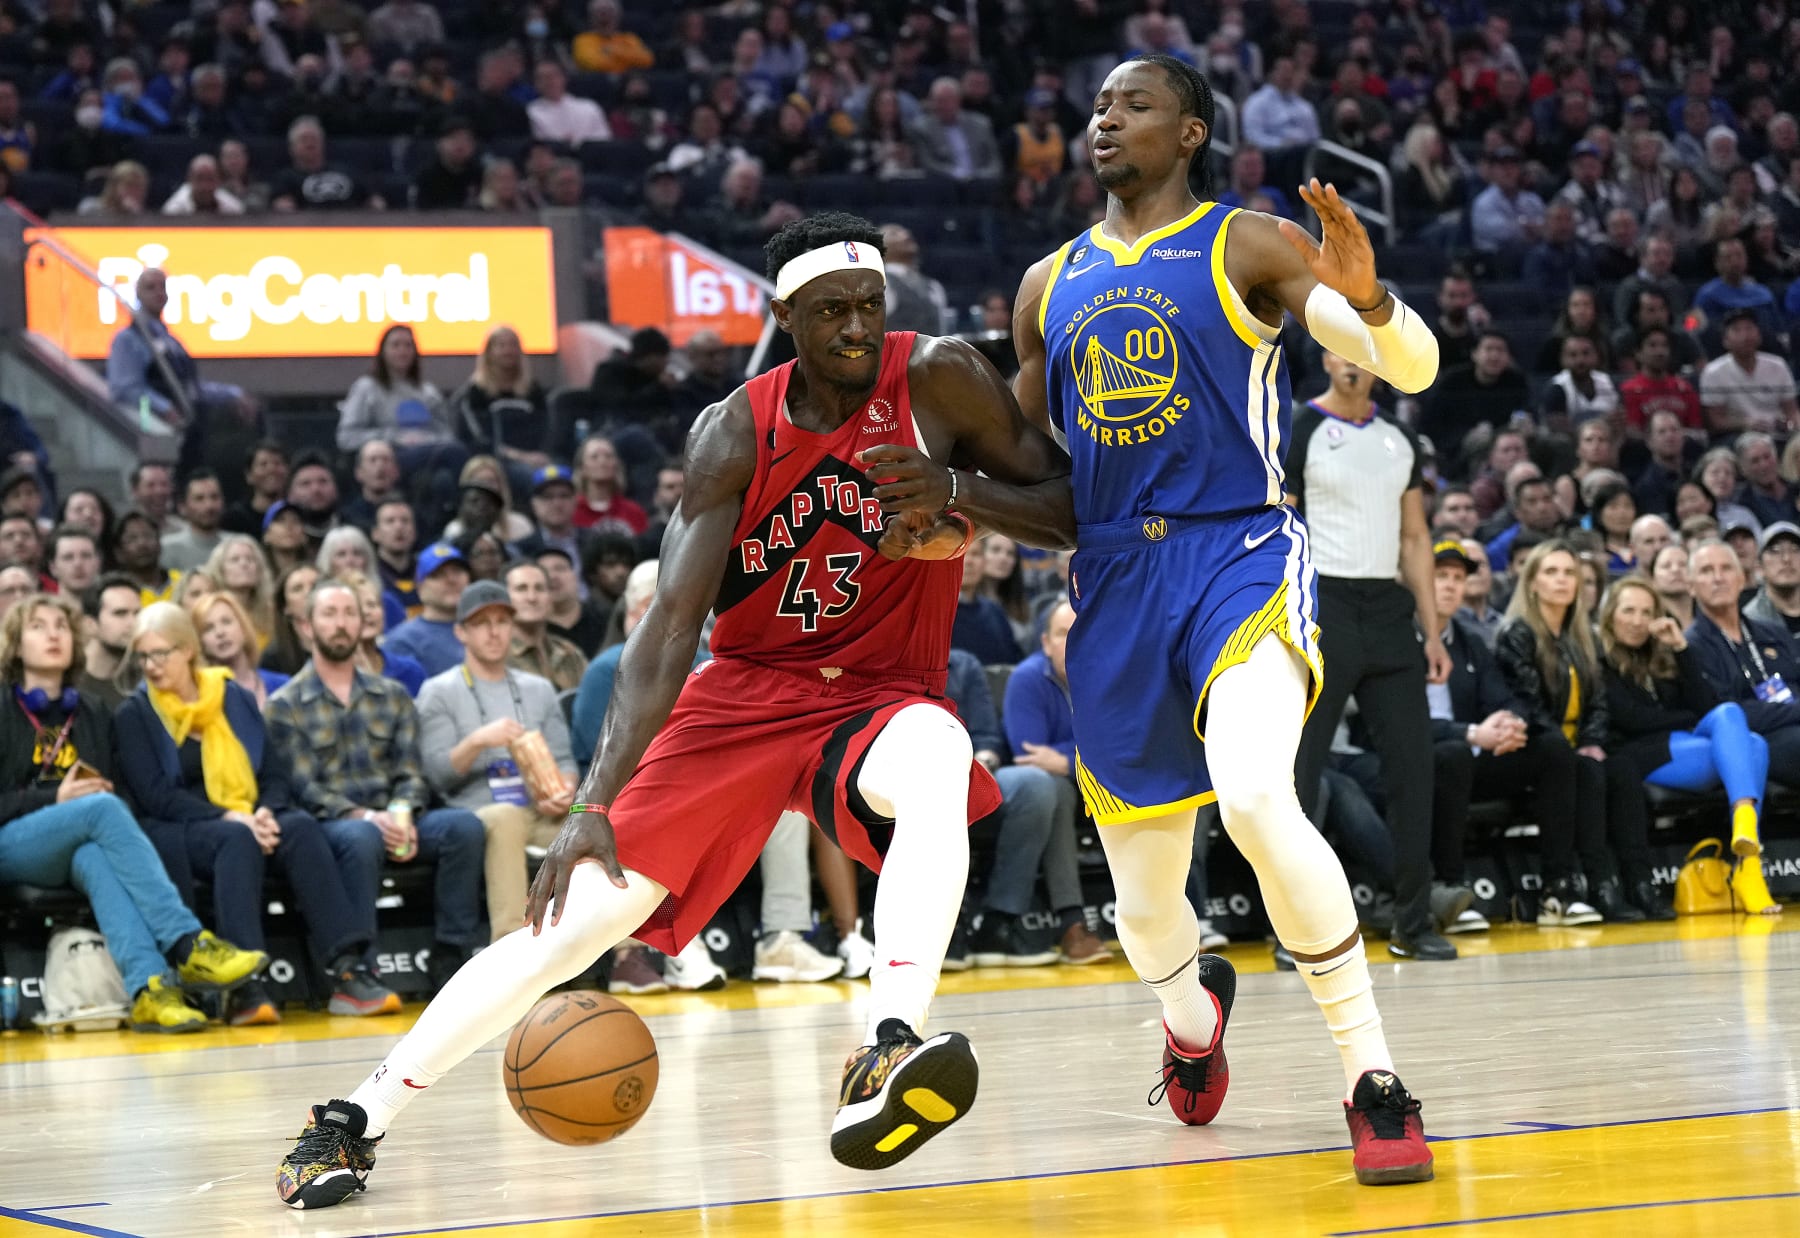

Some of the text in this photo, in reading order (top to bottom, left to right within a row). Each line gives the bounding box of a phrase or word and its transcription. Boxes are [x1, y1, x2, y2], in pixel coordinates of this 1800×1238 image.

[1072, 247, 1087, 264] 6
[1152, 248, 1202, 260] Rakuten
[1065, 286, 1180, 334] GOLDEN STATE
[1125, 326, 1165, 362] 00
[862, 425, 882, 435] Sun
[1077, 393, 1191, 447] WARRIORS
[741, 475, 896, 574] RAPTOR
[1143, 518, 1165, 539] W
[776, 551, 862, 632] 43
